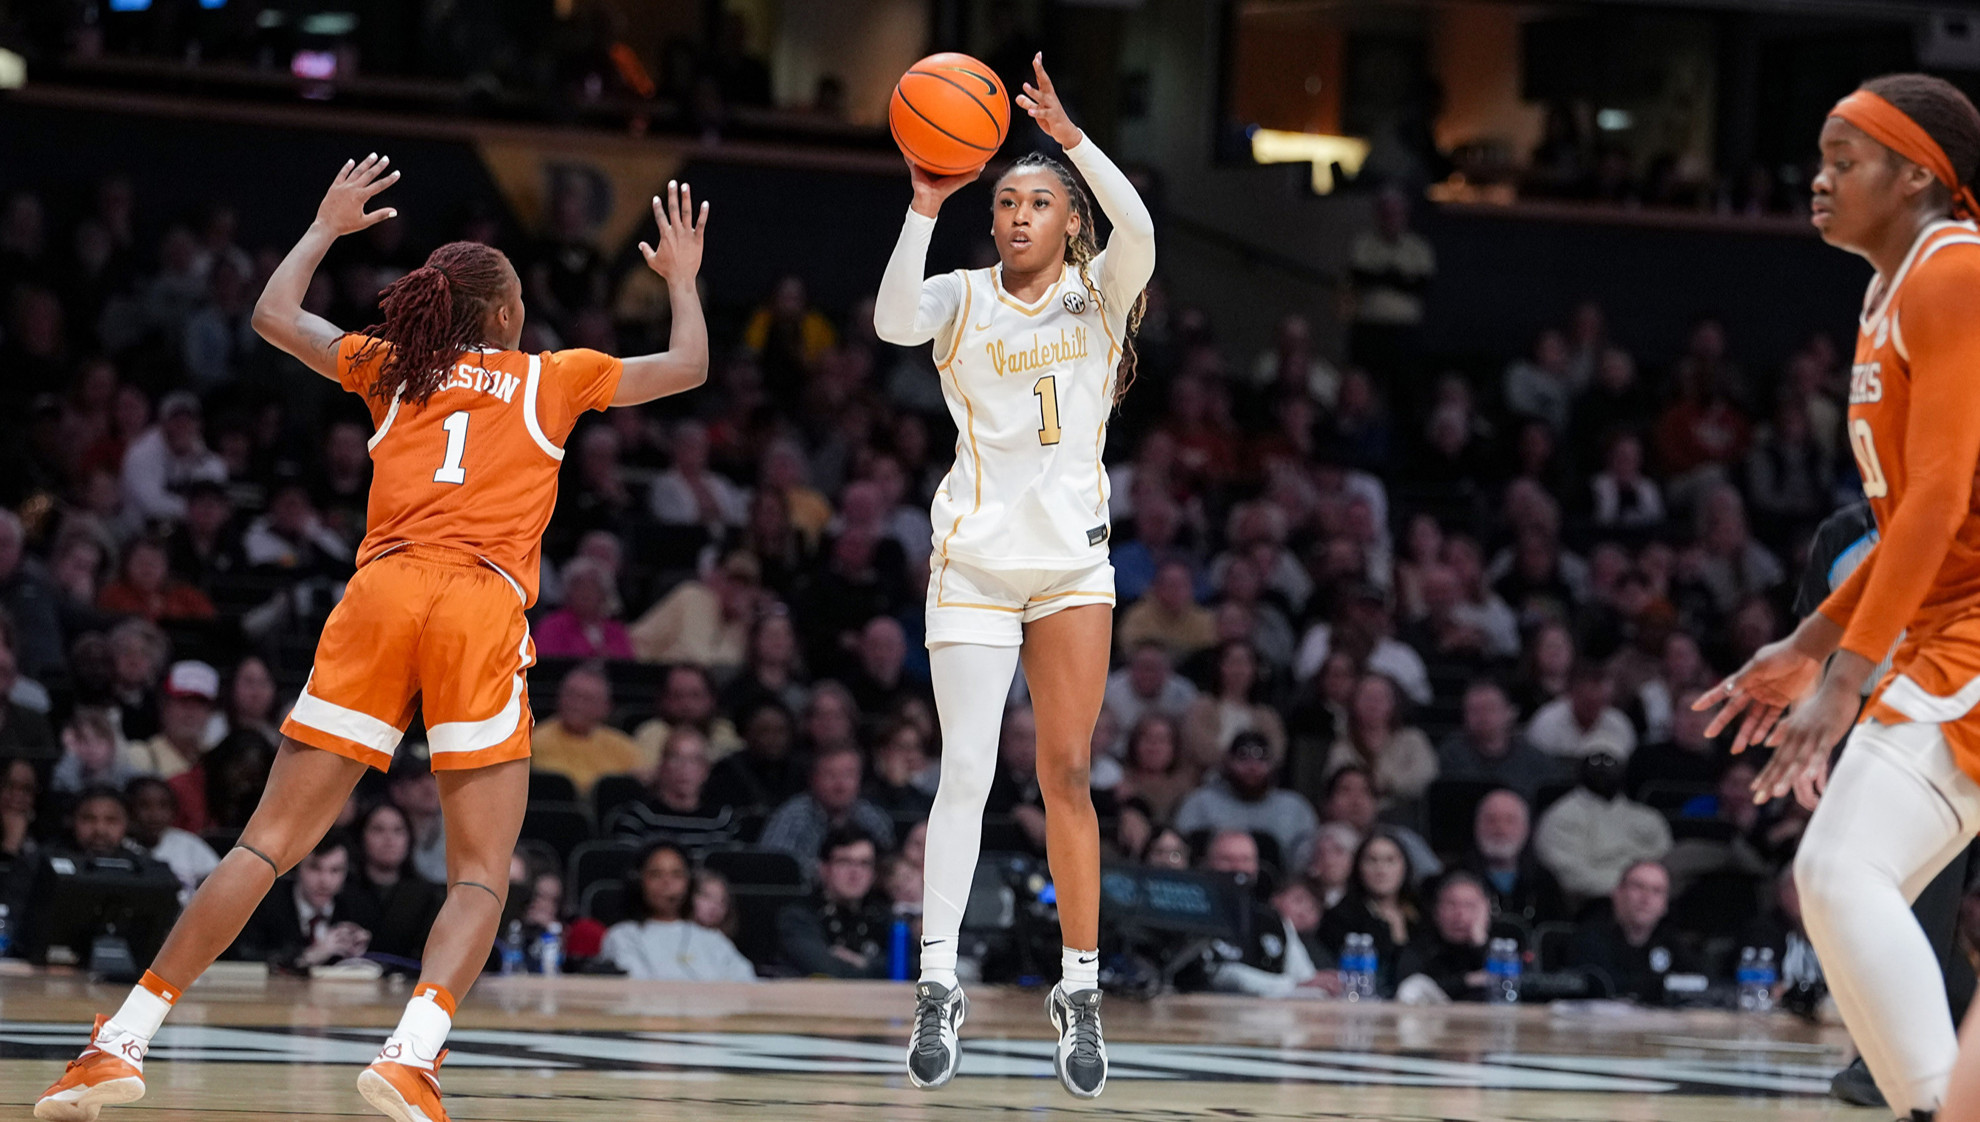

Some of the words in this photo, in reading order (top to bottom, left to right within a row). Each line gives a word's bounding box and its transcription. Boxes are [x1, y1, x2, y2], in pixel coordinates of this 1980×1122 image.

[986, 326, 1088, 377] Vanderbilt
[1033, 375, 1061, 446] 1
[433, 410, 470, 485] 1
